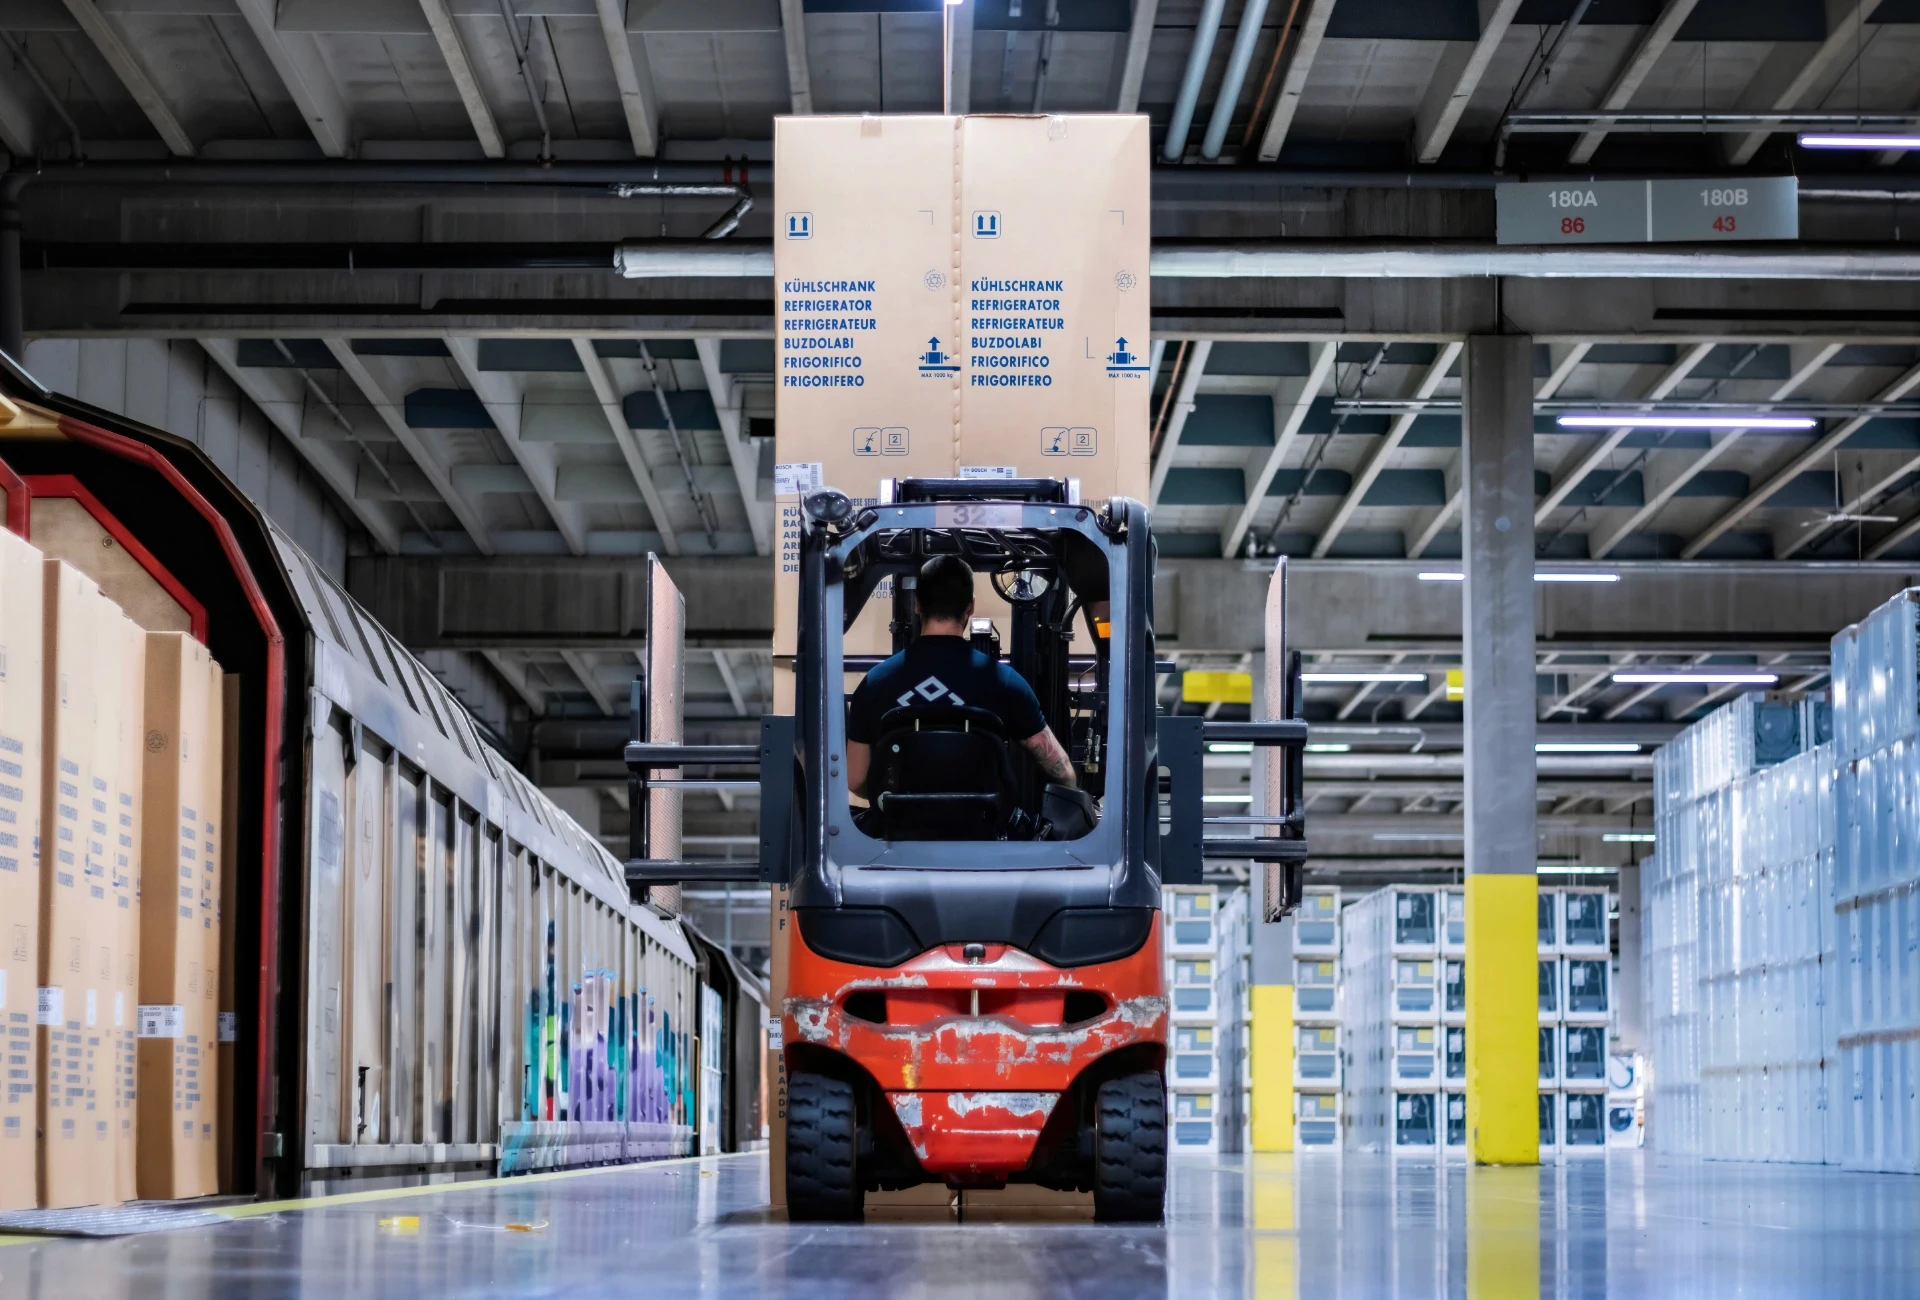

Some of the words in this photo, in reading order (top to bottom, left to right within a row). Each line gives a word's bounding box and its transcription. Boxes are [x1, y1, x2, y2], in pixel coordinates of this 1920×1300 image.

[1548, 190, 1598, 208] 180A
[1700, 188, 1748, 206] 180B
[1560, 217, 1585, 234] 86
[1712, 215, 1736, 232] 43
[783, 277, 877, 293] KÜHLSCHRANK
[971, 276, 1064, 293] KÜHLSCHRANK
[783, 299, 873, 312] REFRIGERATOR
[971, 298, 1061, 312] REFRIGERATOR
[783, 317, 877, 331] REFRIGERATEUR
[971, 317, 1065, 331] REFRIGERATEUR
[783, 337, 855, 350] BUZDOLABI
[971, 336, 1043, 350] BUZDOLABI
[783, 355, 863, 369] FRIGORIFICO
[971, 355, 1051, 368] FRIGORIFICO
[783, 374, 865, 387] FRIGORIFERO
[971, 373, 1053, 387] FRIGORIFERO
[892, 435, 899, 444] 2
[1079, 435, 1086, 444] 2
